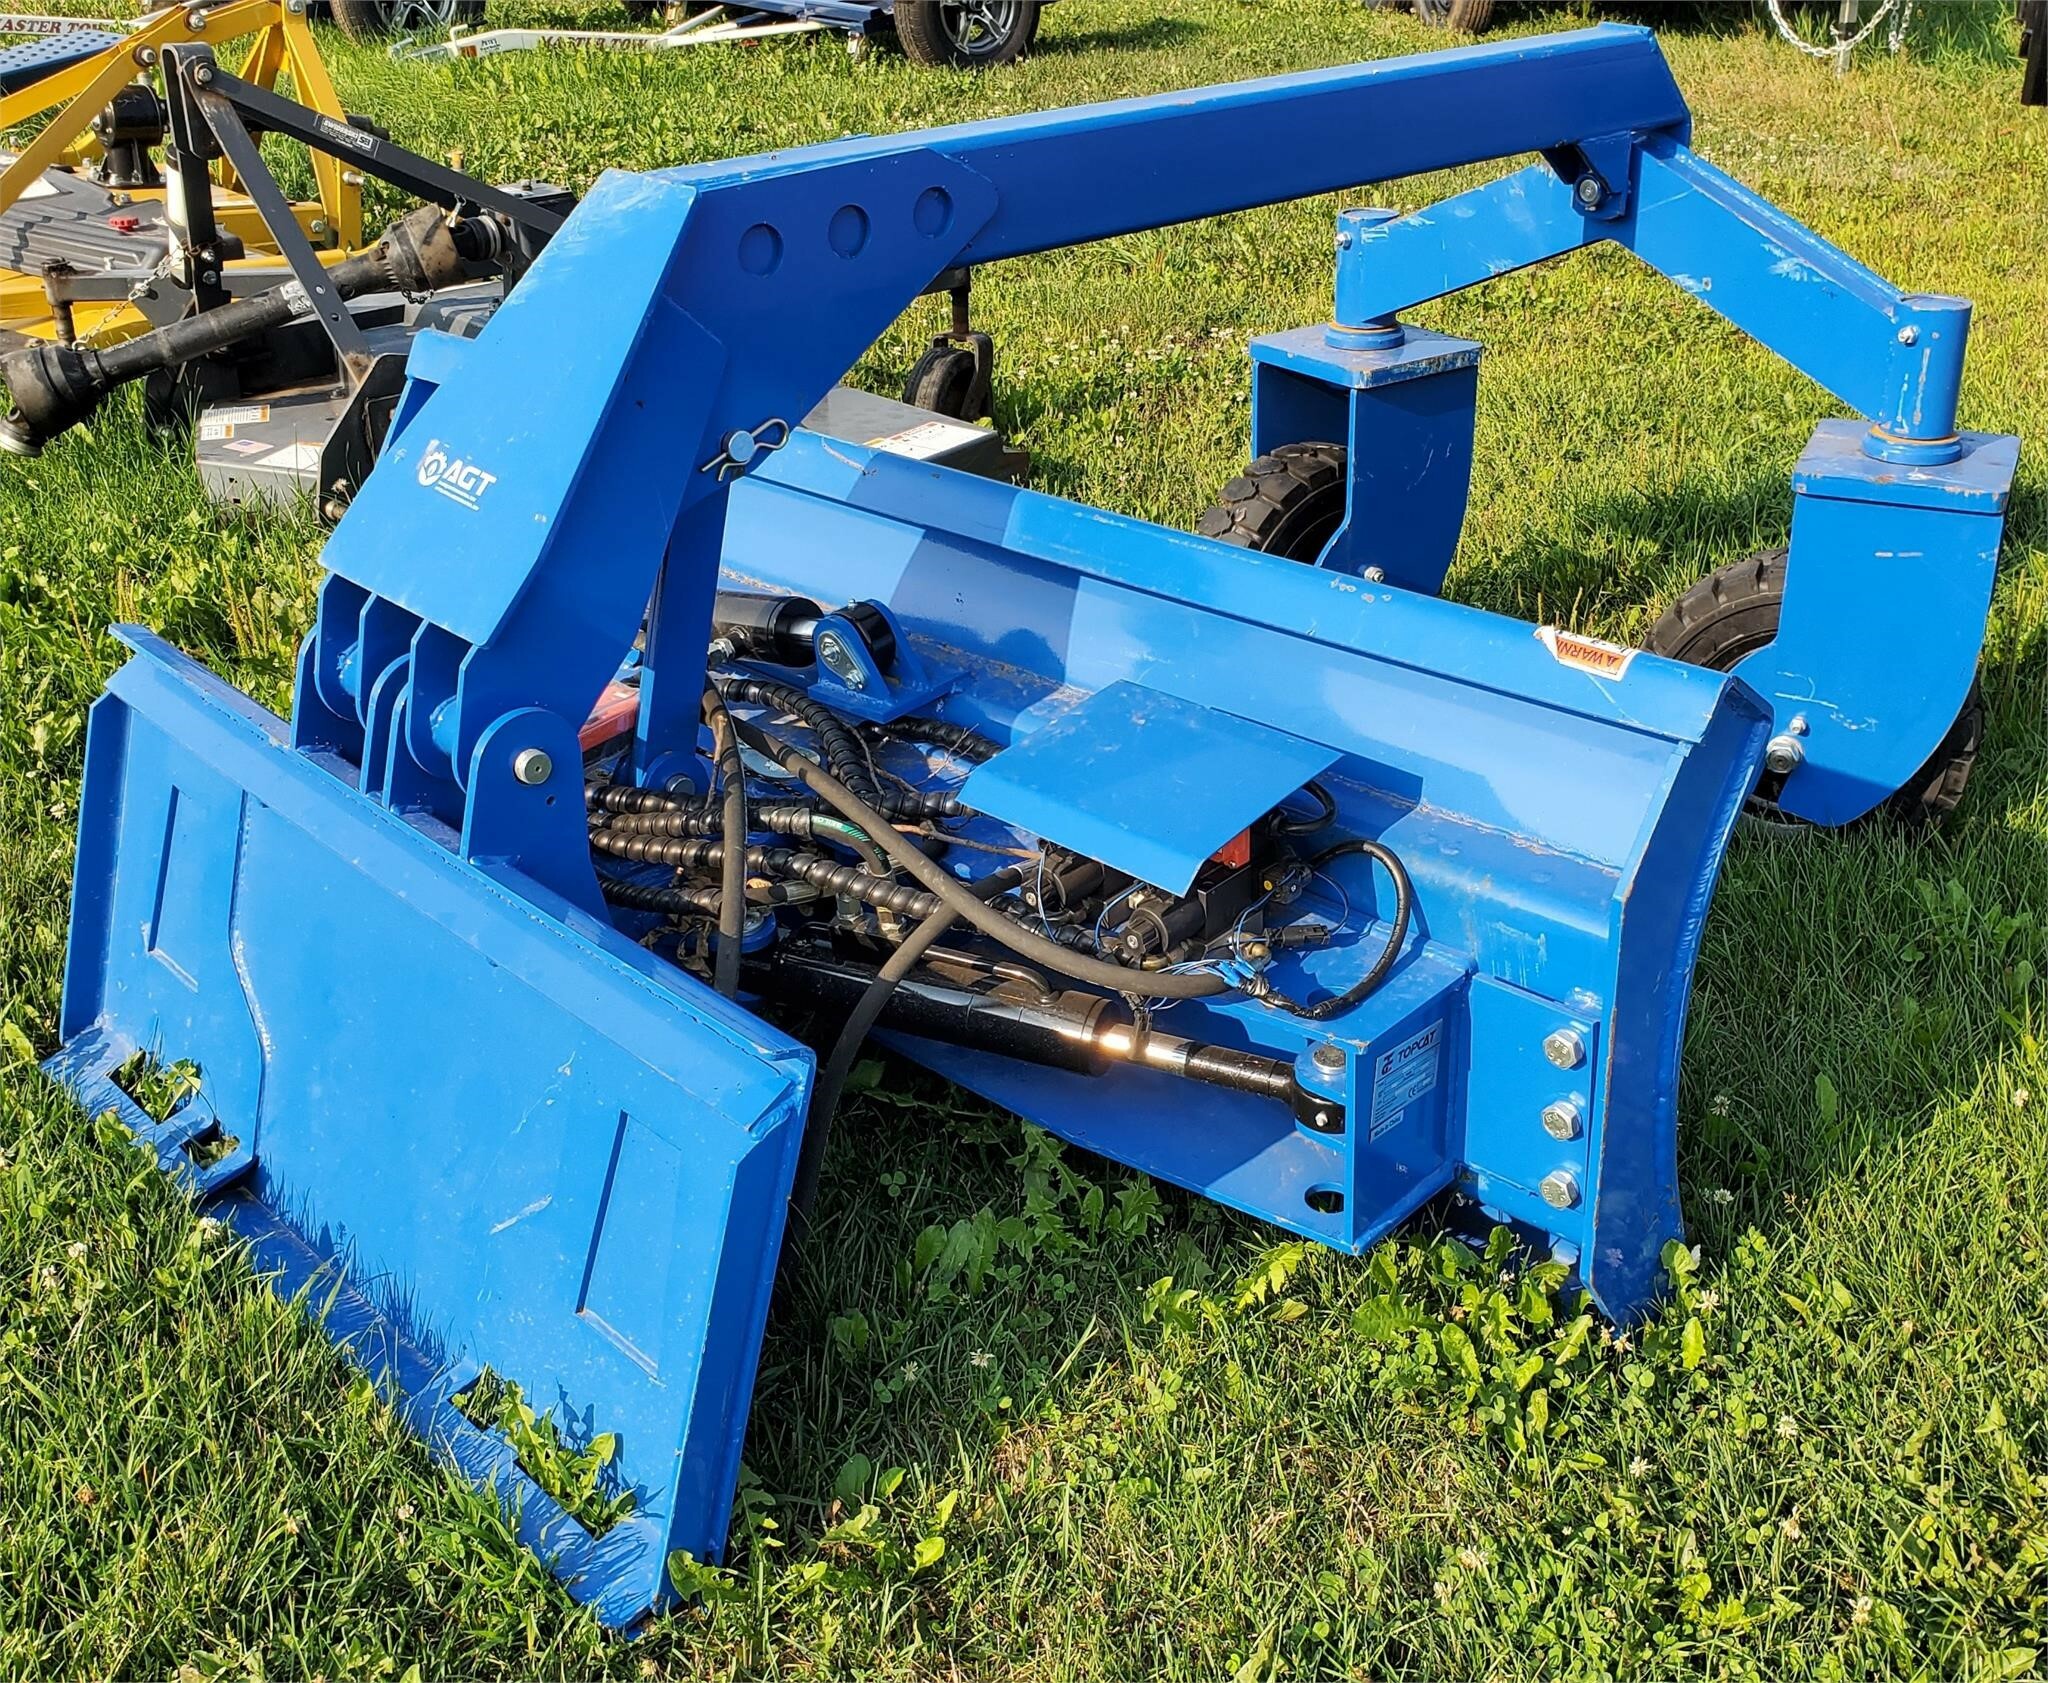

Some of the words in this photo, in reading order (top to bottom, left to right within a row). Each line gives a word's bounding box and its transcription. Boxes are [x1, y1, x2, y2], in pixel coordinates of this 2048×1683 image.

[0, 18, 62, 34] ASTER
[441, 458, 498, 497] AGT
[1556, 638, 1603, 666] WARNI
[1397, 1028, 1438, 1063] TOPCAT
